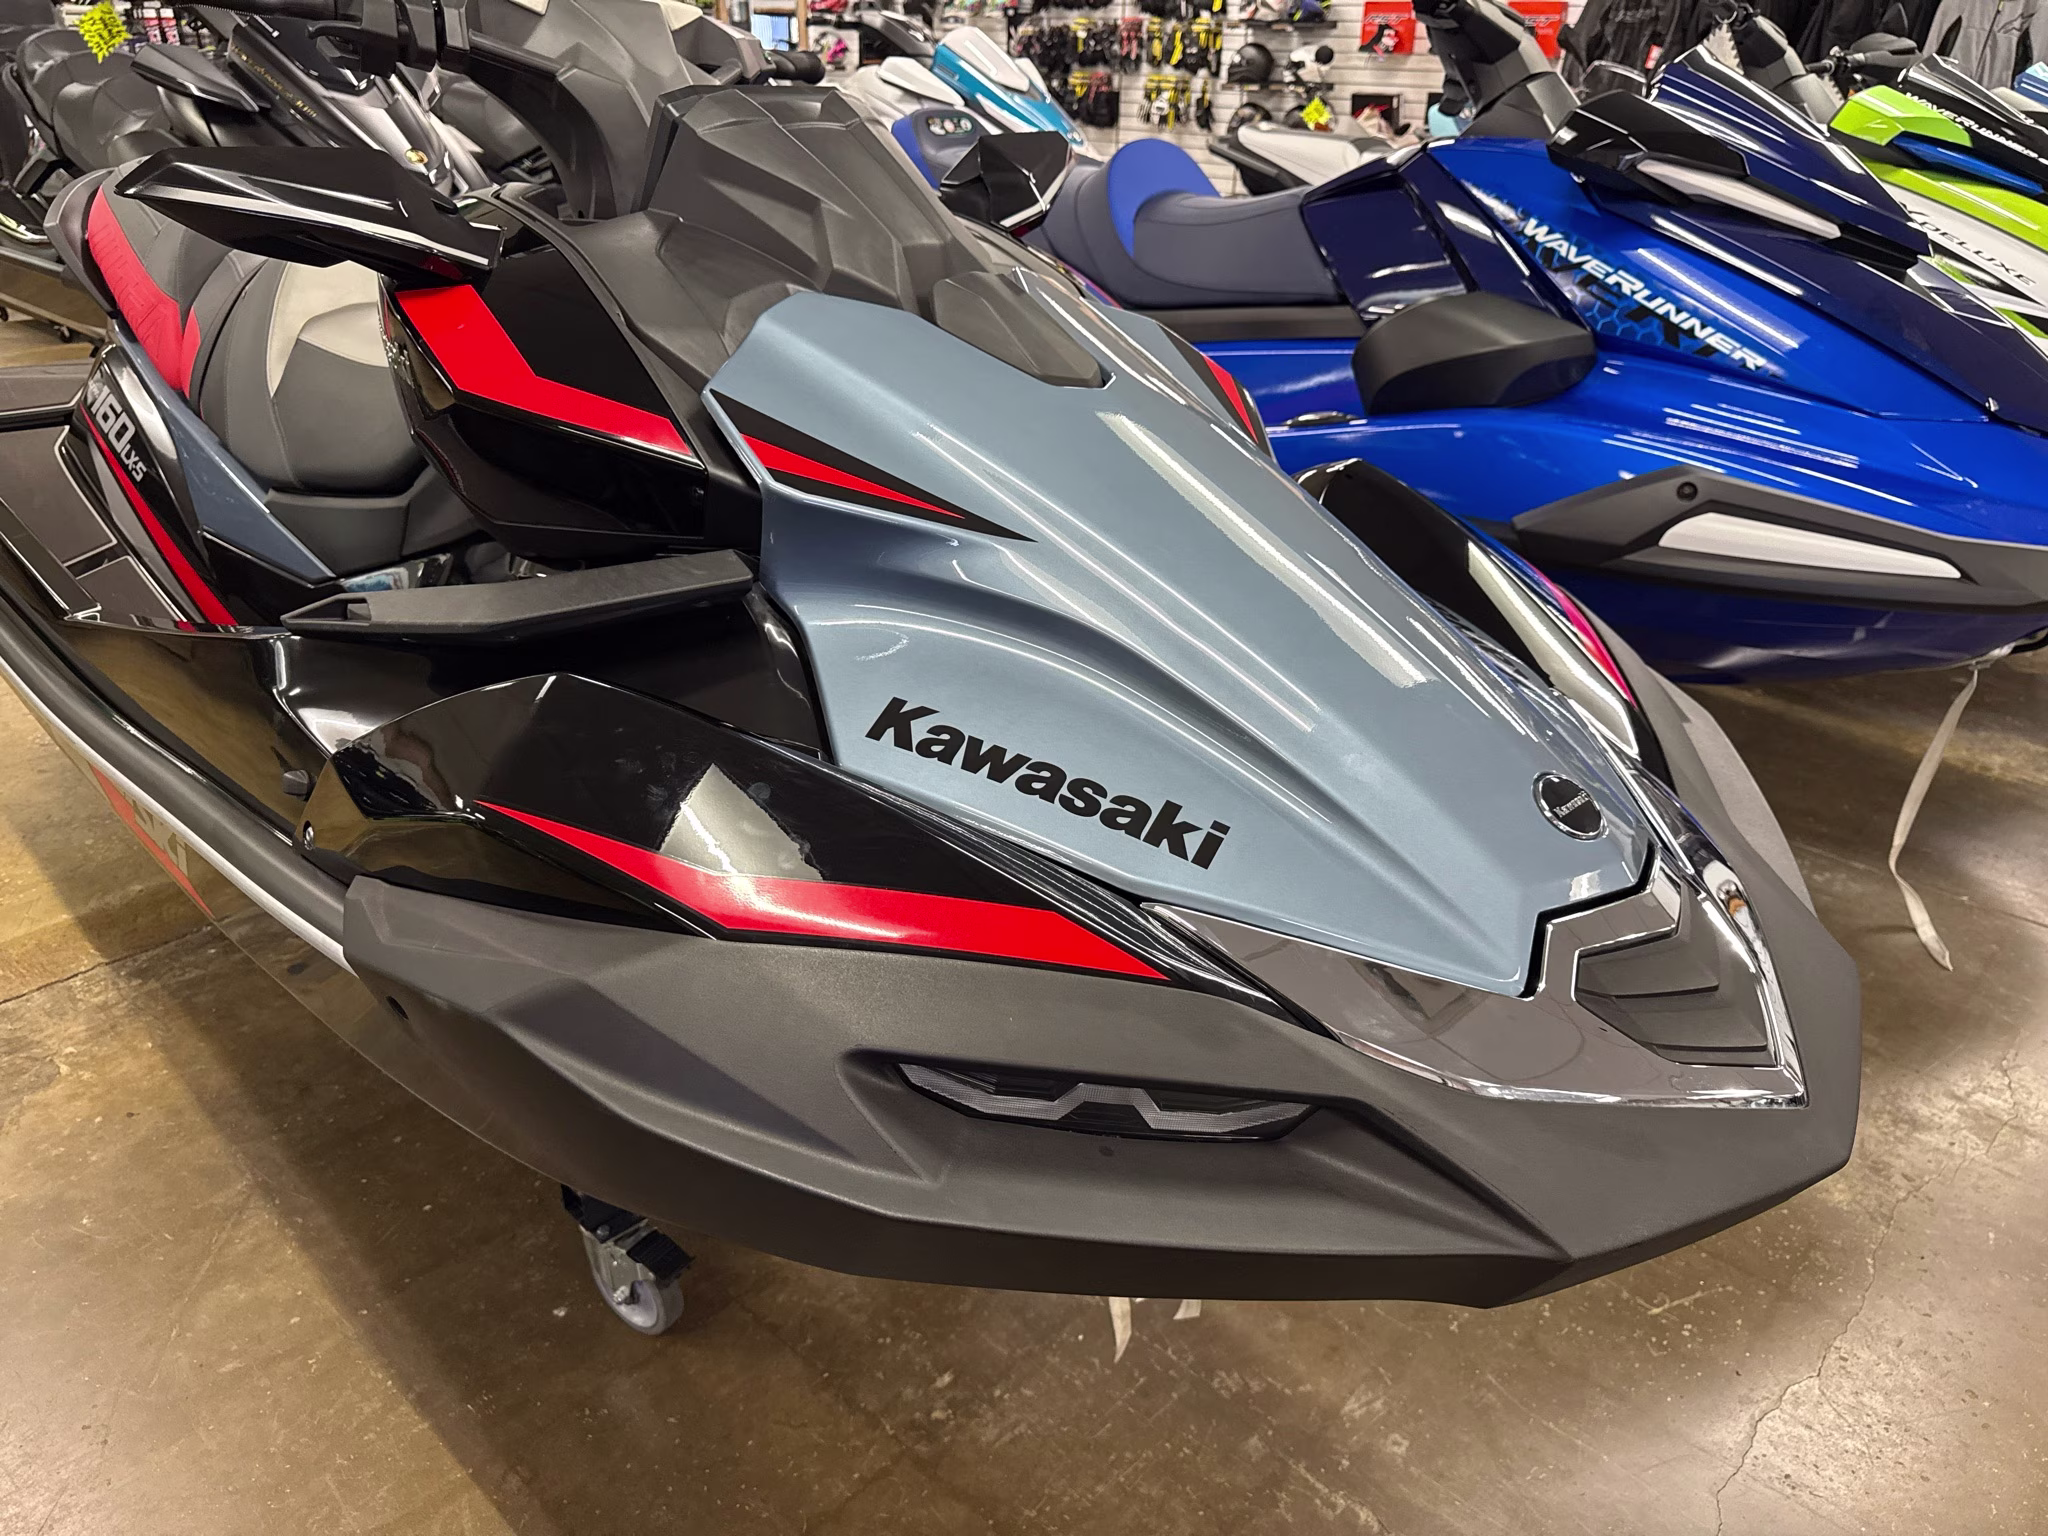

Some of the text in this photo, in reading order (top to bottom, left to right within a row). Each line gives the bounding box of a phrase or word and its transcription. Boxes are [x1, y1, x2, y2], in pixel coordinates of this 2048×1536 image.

[1524, 14, 1560, 27] ST
[1919, 220, 2037, 287] DELUXE
[865, 696, 1231, 870] Kawasaki
